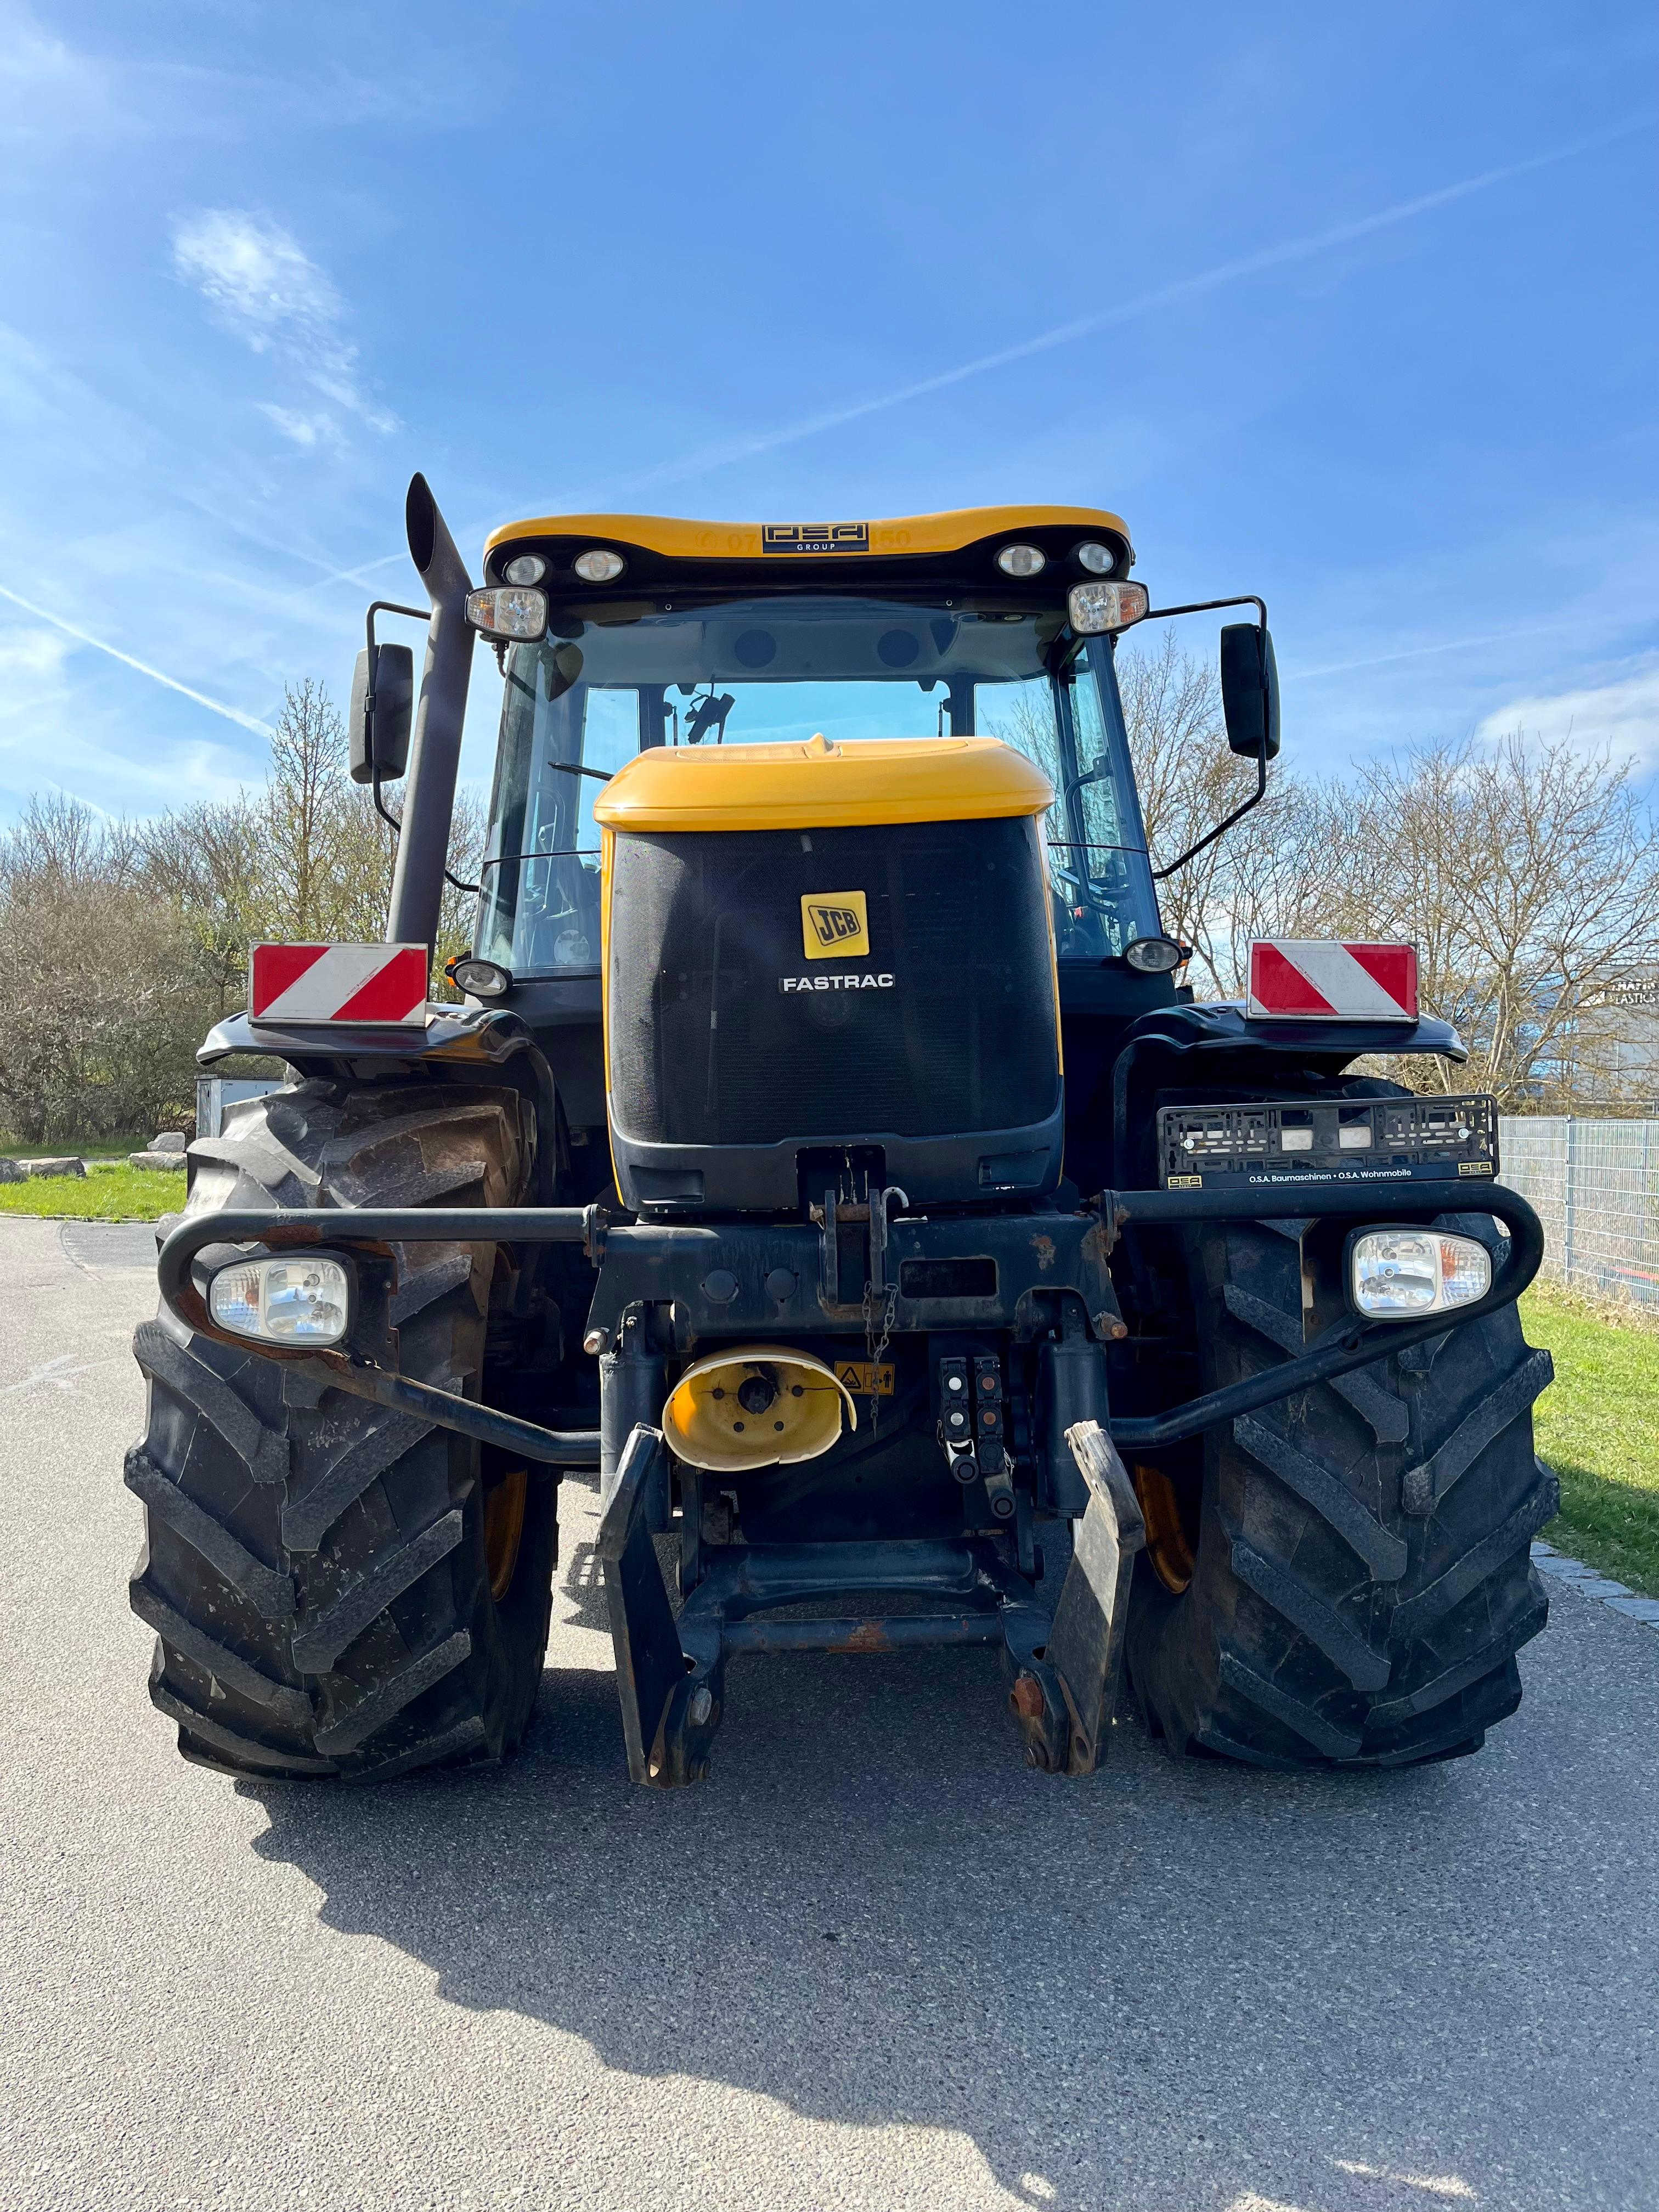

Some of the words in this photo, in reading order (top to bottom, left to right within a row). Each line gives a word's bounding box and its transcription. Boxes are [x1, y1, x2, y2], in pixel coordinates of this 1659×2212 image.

[817, 910, 857, 941] JCB
[783, 974, 894, 991] FASTRAC
[1271, 1173, 1332, 1182] Baumaschinen
[1360, 1169, 1412, 1178] Wohnmobile
